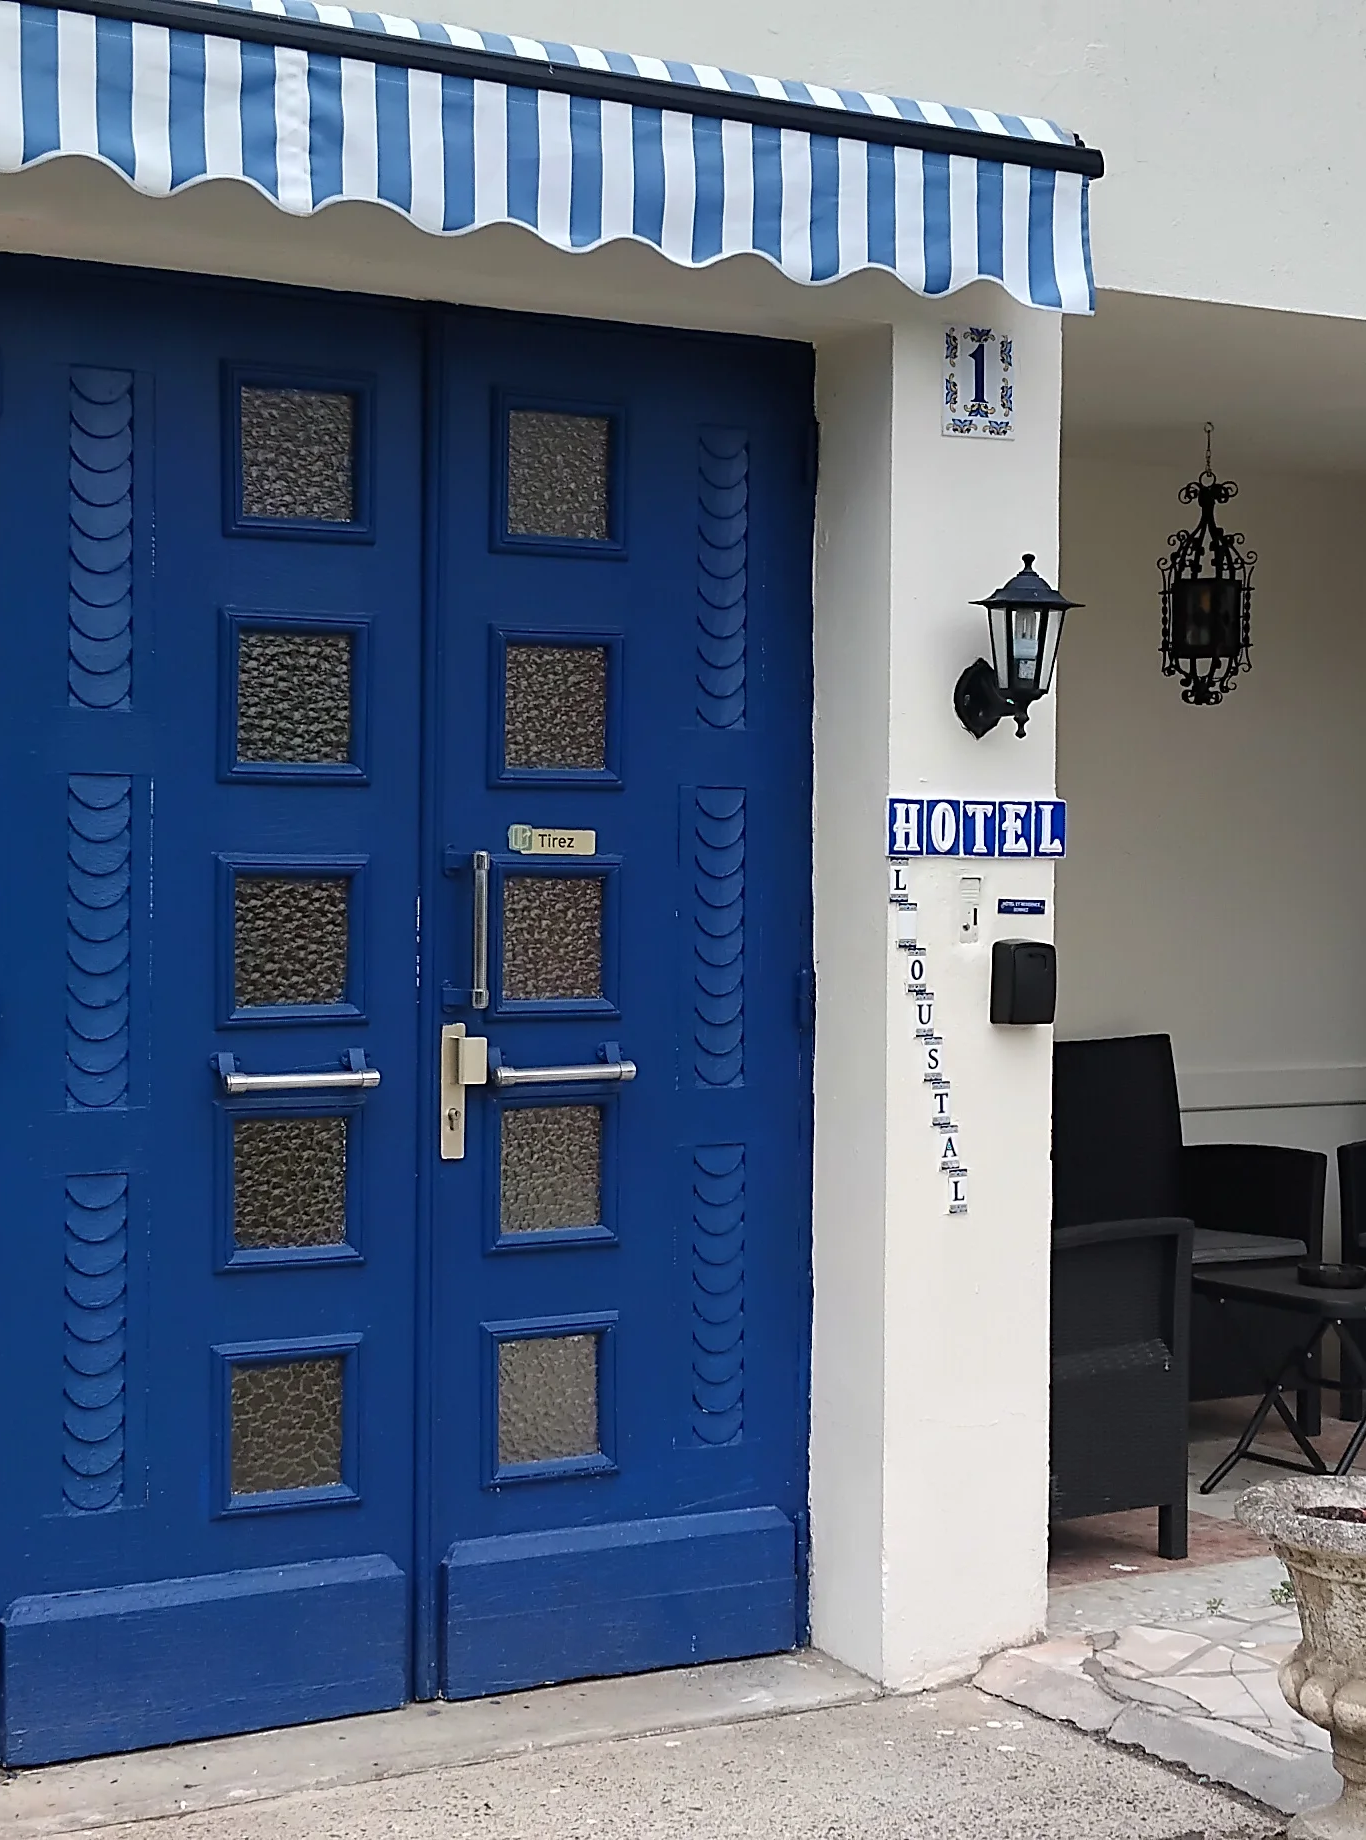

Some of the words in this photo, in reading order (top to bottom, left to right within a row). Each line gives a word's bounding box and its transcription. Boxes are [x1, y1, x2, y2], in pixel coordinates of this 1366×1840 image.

[968, 343, 989, 403] 1
[538, 834, 575, 848] Tirez
[893, 802, 1062, 853] HOTEL
